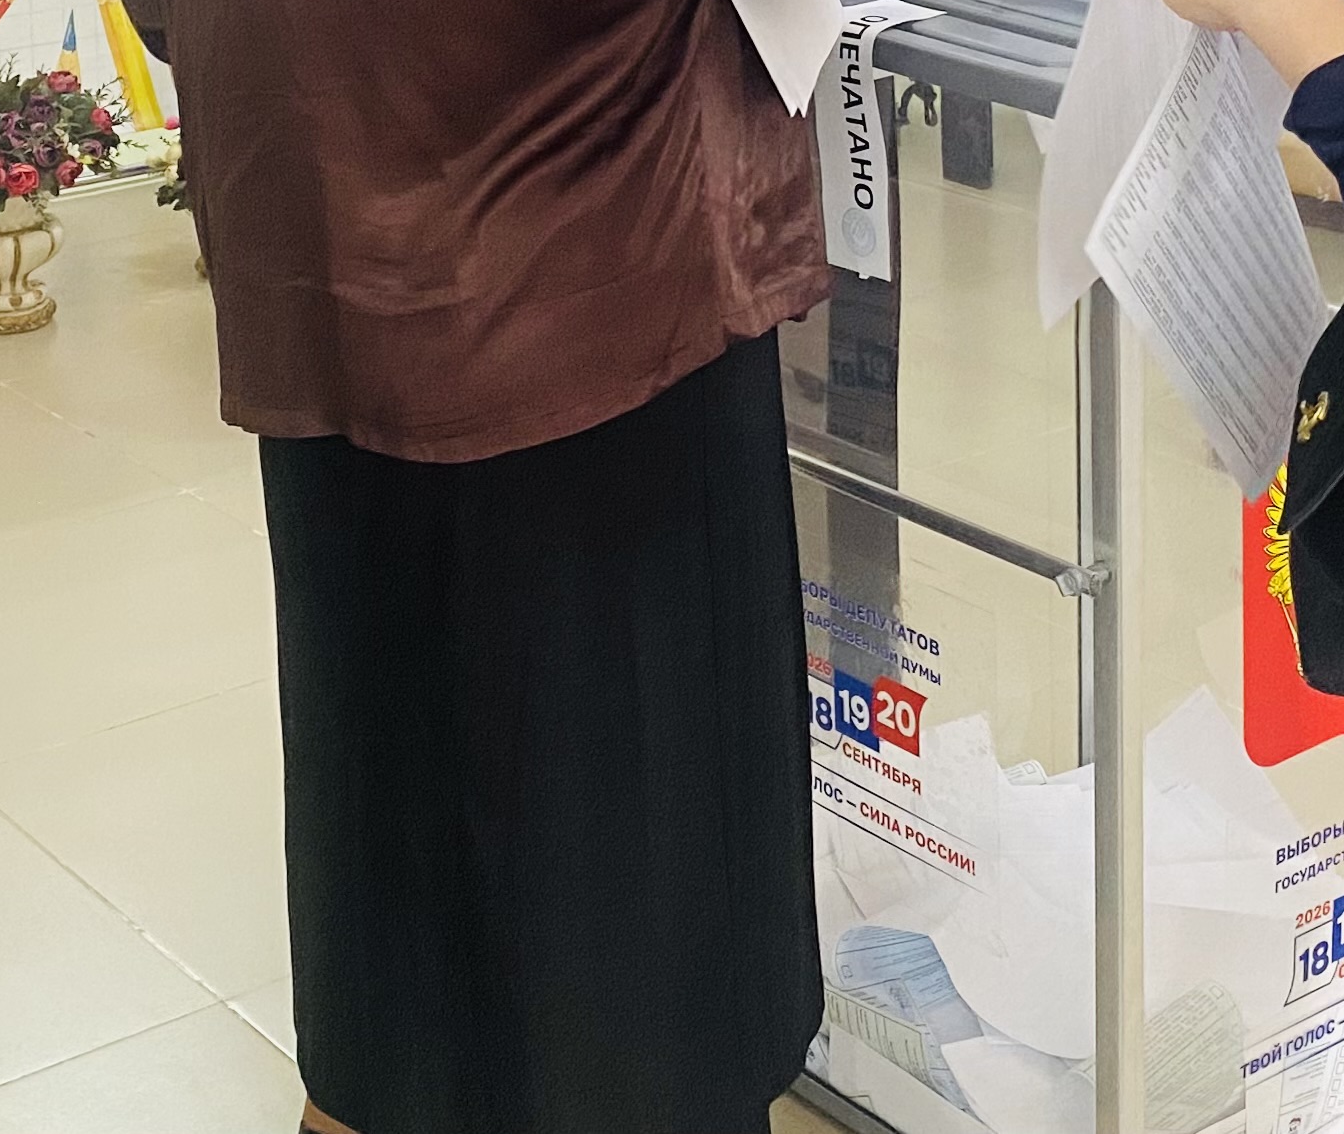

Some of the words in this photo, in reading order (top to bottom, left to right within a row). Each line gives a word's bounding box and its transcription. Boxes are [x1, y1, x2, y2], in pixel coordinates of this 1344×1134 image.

[839, 15, 888, 210] ОПЕЧАТАНО
[846, 599, 940, 656] ДЕПУТАТОВ
[901, 657, 941, 686] ДУМЫ
[838, 689, 870, 731] 19
[876, 690, 916, 738] 20
[842, 742, 921, 796] СЕНТЯБРЯ
[859, 801, 901, 836] СИЛА
[905, 824, 976, 876] РОССИИ!
[1295, 900, 1331, 929] 2026
[1299, 941, 1329, 982] 18
[1240, 1042, 1282, 1079] ТВОЙ
[1285, 1019, 1335, 1057] ГОЛОС
